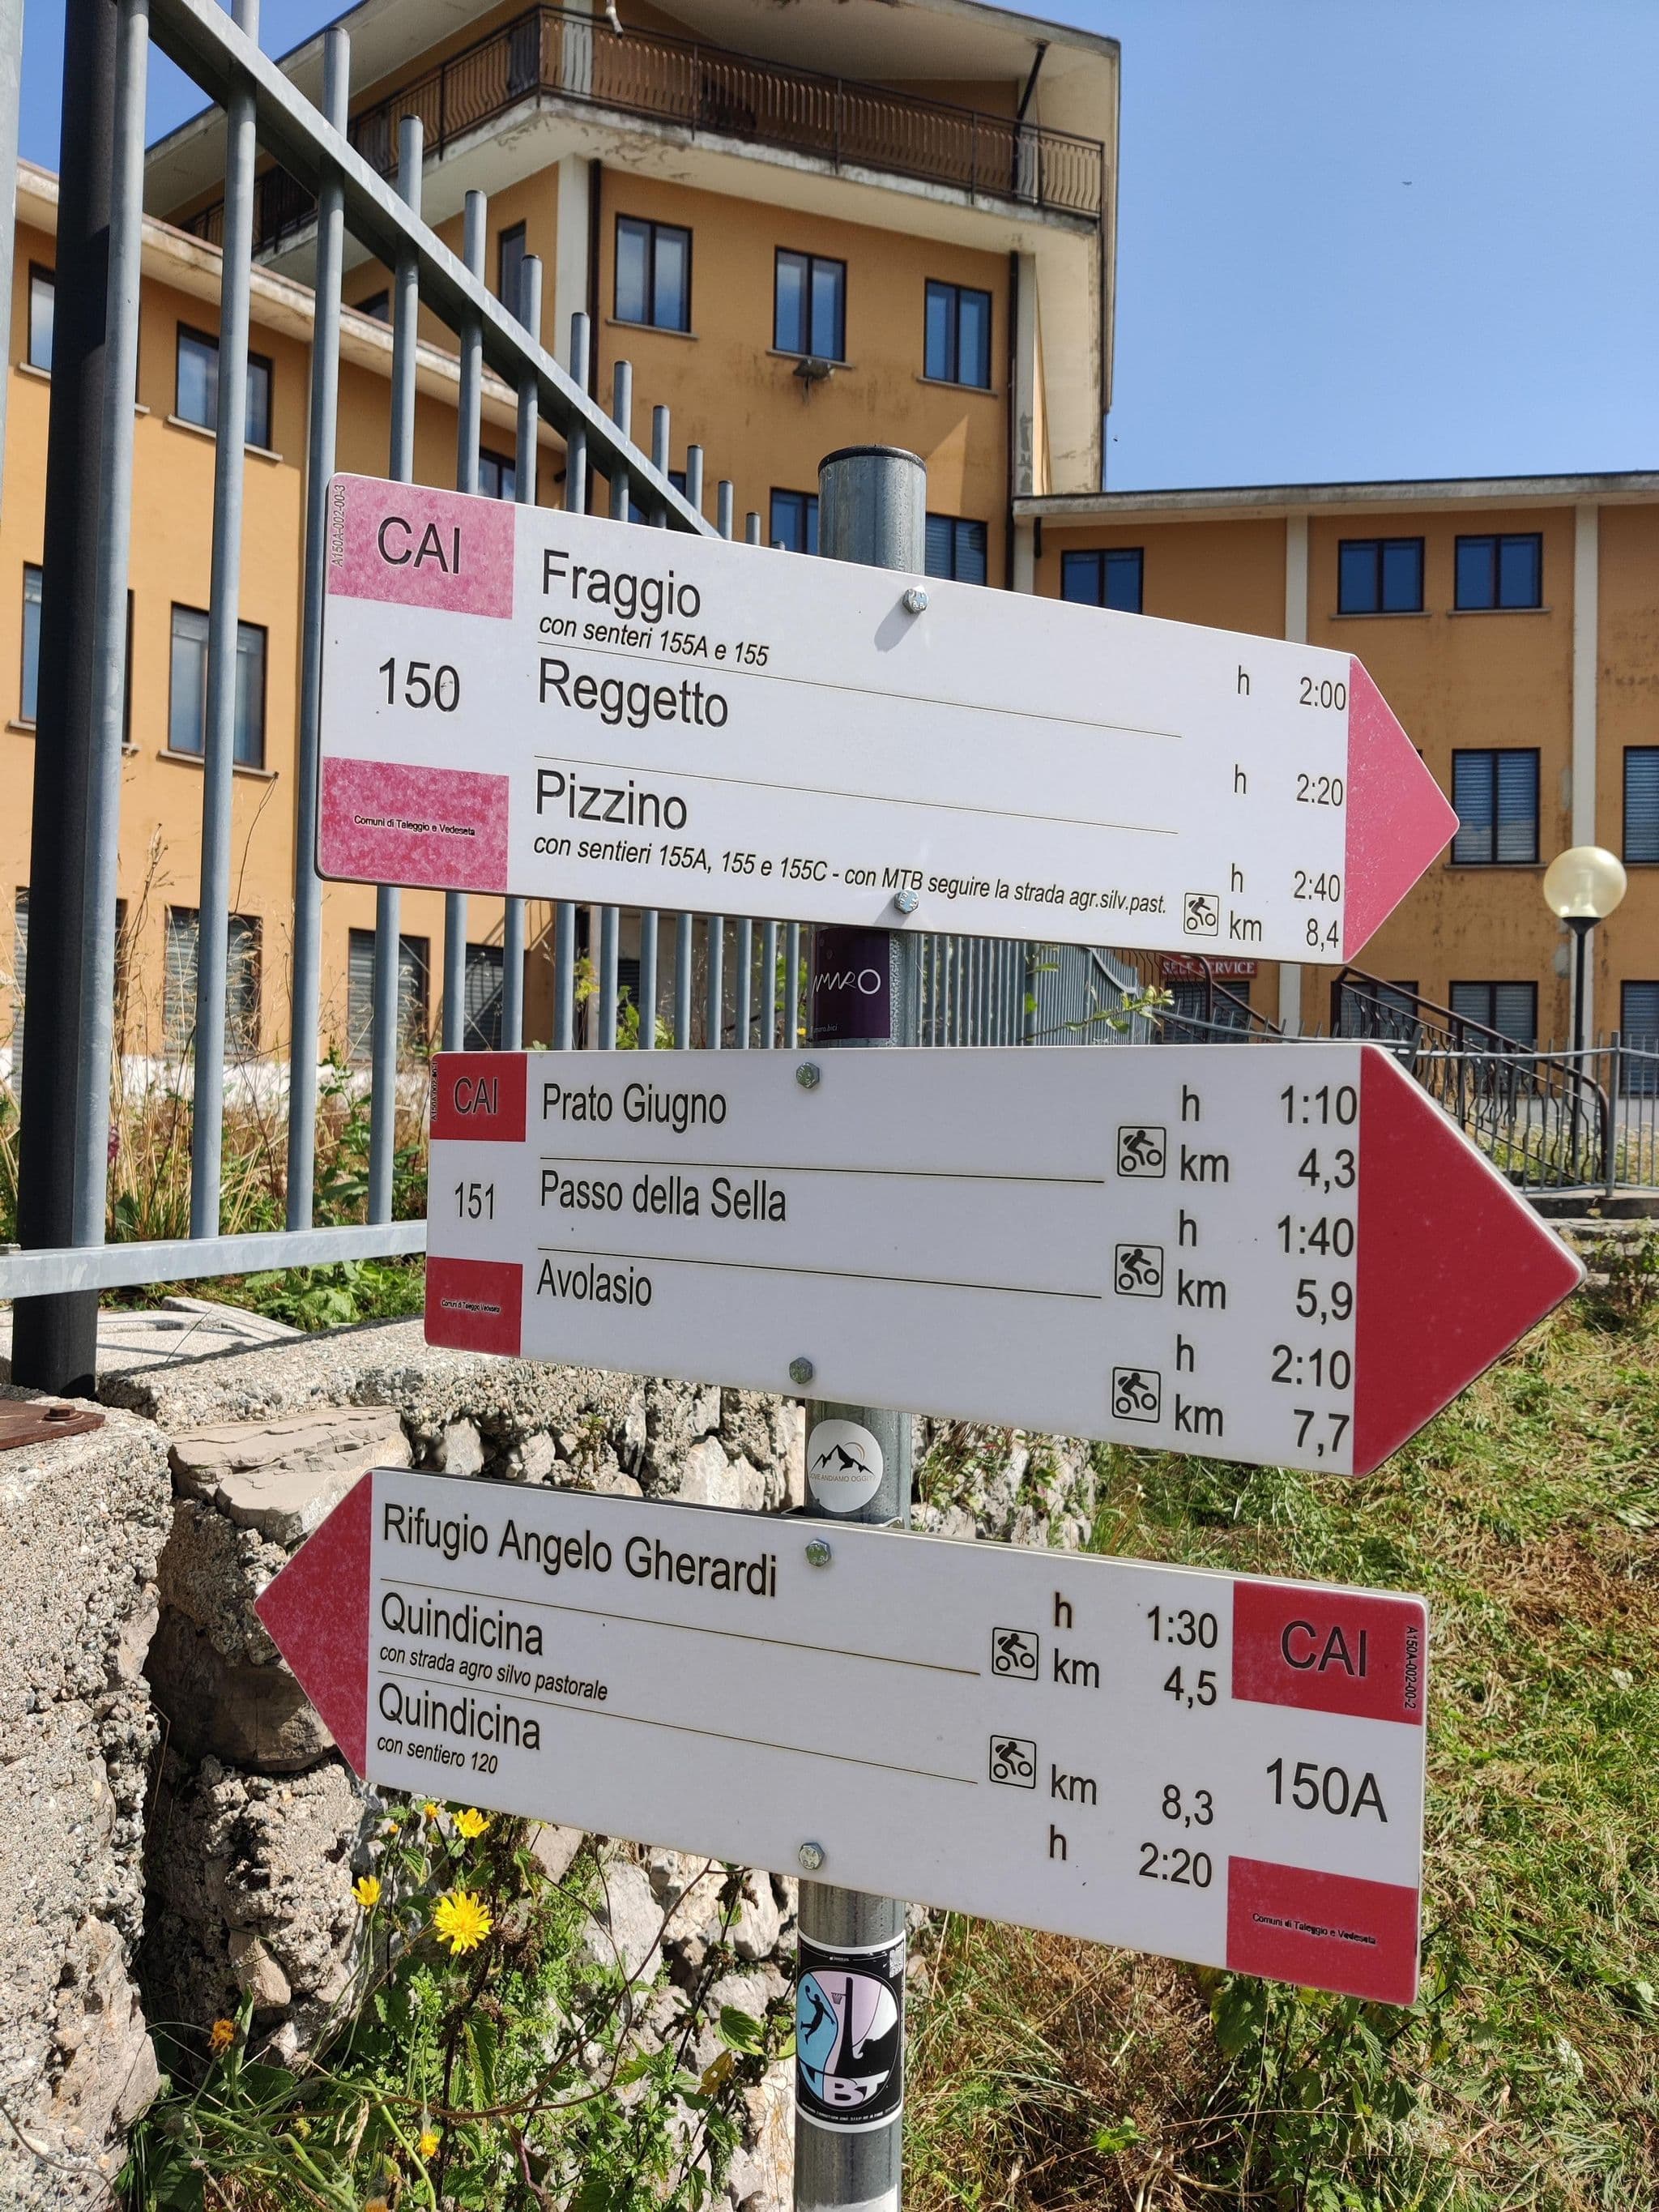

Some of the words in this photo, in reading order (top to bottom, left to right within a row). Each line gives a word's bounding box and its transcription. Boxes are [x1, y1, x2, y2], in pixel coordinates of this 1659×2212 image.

[331, 485, 345, 567] A150A-002-00-3
[377, 516, 460, 574] CAI
[543, 549, 701, 624] Fraggio
[539, 616, 578, 638] con
[582, 623, 653, 649] senteri
[660, 630, 708, 658] 155A
[714, 643, 727, 660] e
[735, 641, 770, 667] 155
[379, 657, 460, 712] 150
[539, 656, 728, 729] Reggetto
[1237, 664, 1250, 696] h
[1299, 676, 1346, 711] 2:00
[536, 768, 687, 831] Pizzino
[1234, 763, 1247, 795] h
[1296, 773, 1344, 807] 2:20
[354, 815, 385, 827] Comuni
[387, 819, 394, 827] di
[396, 819, 430, 833] Taleggio
[534, 836, 571, 856] con
[577, 839, 653, 865] sentieri
[659, 844, 712, 874] 155A,
[722, 851, 757, 874] 155
[761, 860, 773, 877] e
[781, 856, 828, 882] 155C
[844, 869, 876, 887] con
[881, 867, 923, 890] MTB
[928, 876, 991, 899] seguire
[994, 878, 1009, 899] la
[1013, 882, 1065, 904] strada
[1068, 889, 1166, 916] agr.silv.past.
[1230, 862, 1243, 893] h
[1293, 870, 1341, 903] 2:40
[1229, 910, 1262, 942] km
[1306, 917, 1339, 953] 8,4
[454, 1078, 497, 1114] CAI
[543, 1083, 613, 1122] Prato
[623, 1083, 727, 1134] Giugno
[1181, 1084, 1200, 1122] h
[1281, 1085, 1358, 1125] 1:10
[541, 1169, 623, 1211] Passo
[633, 1174, 699, 1216] della
[710, 1176, 786, 1222] Sella
[1180, 1143, 1229, 1183] km
[1298, 1147, 1356, 1194] 4,3
[454, 1181, 494, 1220] 151
[1179, 1209, 1197, 1247] h
[1277, 1215, 1354, 1258] 1:40
[536, 1258, 652, 1307] Avolasio
[1177, 1268, 1226, 1310] km
[1295, 1278, 1353, 1326] 5,9
[1175, 1334, 1195, 1373] h
[1271, 1343, 1351, 1390] 2:10
[1175, 1393, 1223, 1437] km
[1293, 1408, 1350, 1458] 7,7
[384, 1502, 488, 1561] Rifugio
[497, 1519, 612, 1576] Angelo
[625, 1535, 777, 1598] Gherardi
[381, 1591, 544, 1656] Quindicina
[1054, 1591, 1073, 1629] h
[1147, 1605, 1218, 1649] 1:30
[379, 1646, 406, 1664] con
[409, 1649, 455, 1673] strada
[458, 1660, 493, 1681] agro
[496, 1663, 531, 1687] silvo
[534, 1673, 608, 1702] pastorale
[1281, 1621, 1367, 1677] CAI
[1405, 1625, 1418, 1709] A150A-002-00-2
[1053, 1647, 1100, 1689] km
[1163, 1665, 1217, 1710] 4,5
[377, 1682, 541, 1752] Quindicina
[377, 1736, 403, 1755] con
[407, 1742, 466, 1768] sentiero
[471, 1751, 498, 1774] 120
[1051, 1763, 1097, 1806] km
[1162, 1783, 1213, 1829] 8,3
[1266, 1757, 1388, 1823] 150A
[1049, 1824, 1067, 1861] h
[1138, 1842, 1213, 1888] 2:20
[1252, 1913, 1283, 1927] Comuni
[1285, 1919, 1292, 1928] di
[1294, 1921, 1328, 1936] Taleggio
